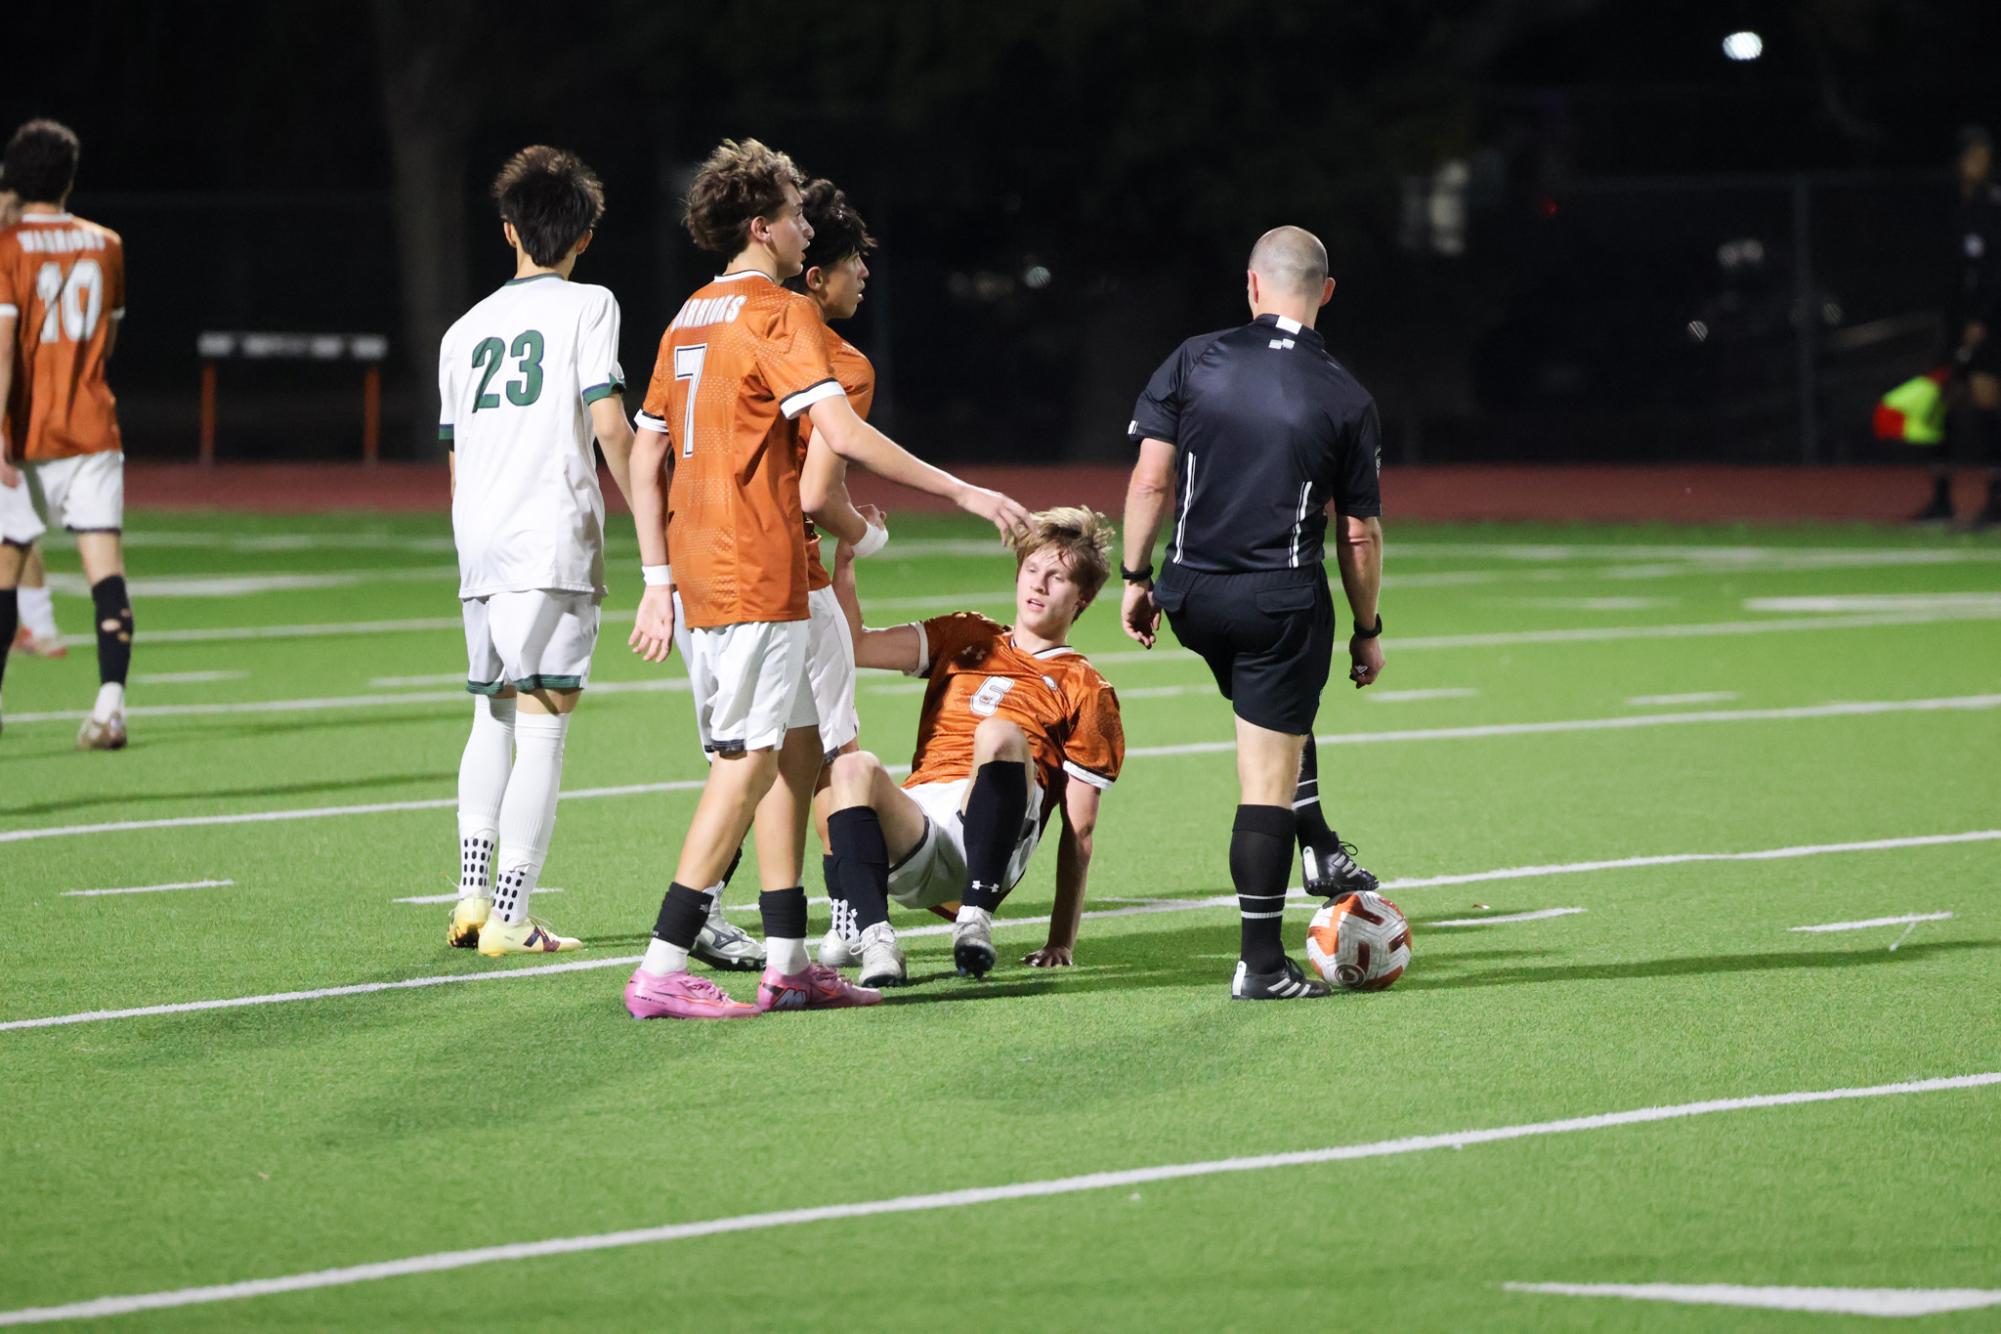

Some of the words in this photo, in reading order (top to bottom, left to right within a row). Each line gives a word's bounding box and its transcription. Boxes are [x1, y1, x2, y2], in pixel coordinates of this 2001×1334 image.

[36, 259, 103, 343] 10
[471, 329, 545, 413] 23
[674, 343, 708, 458] 7
[970, 675, 1014, 715] 6
